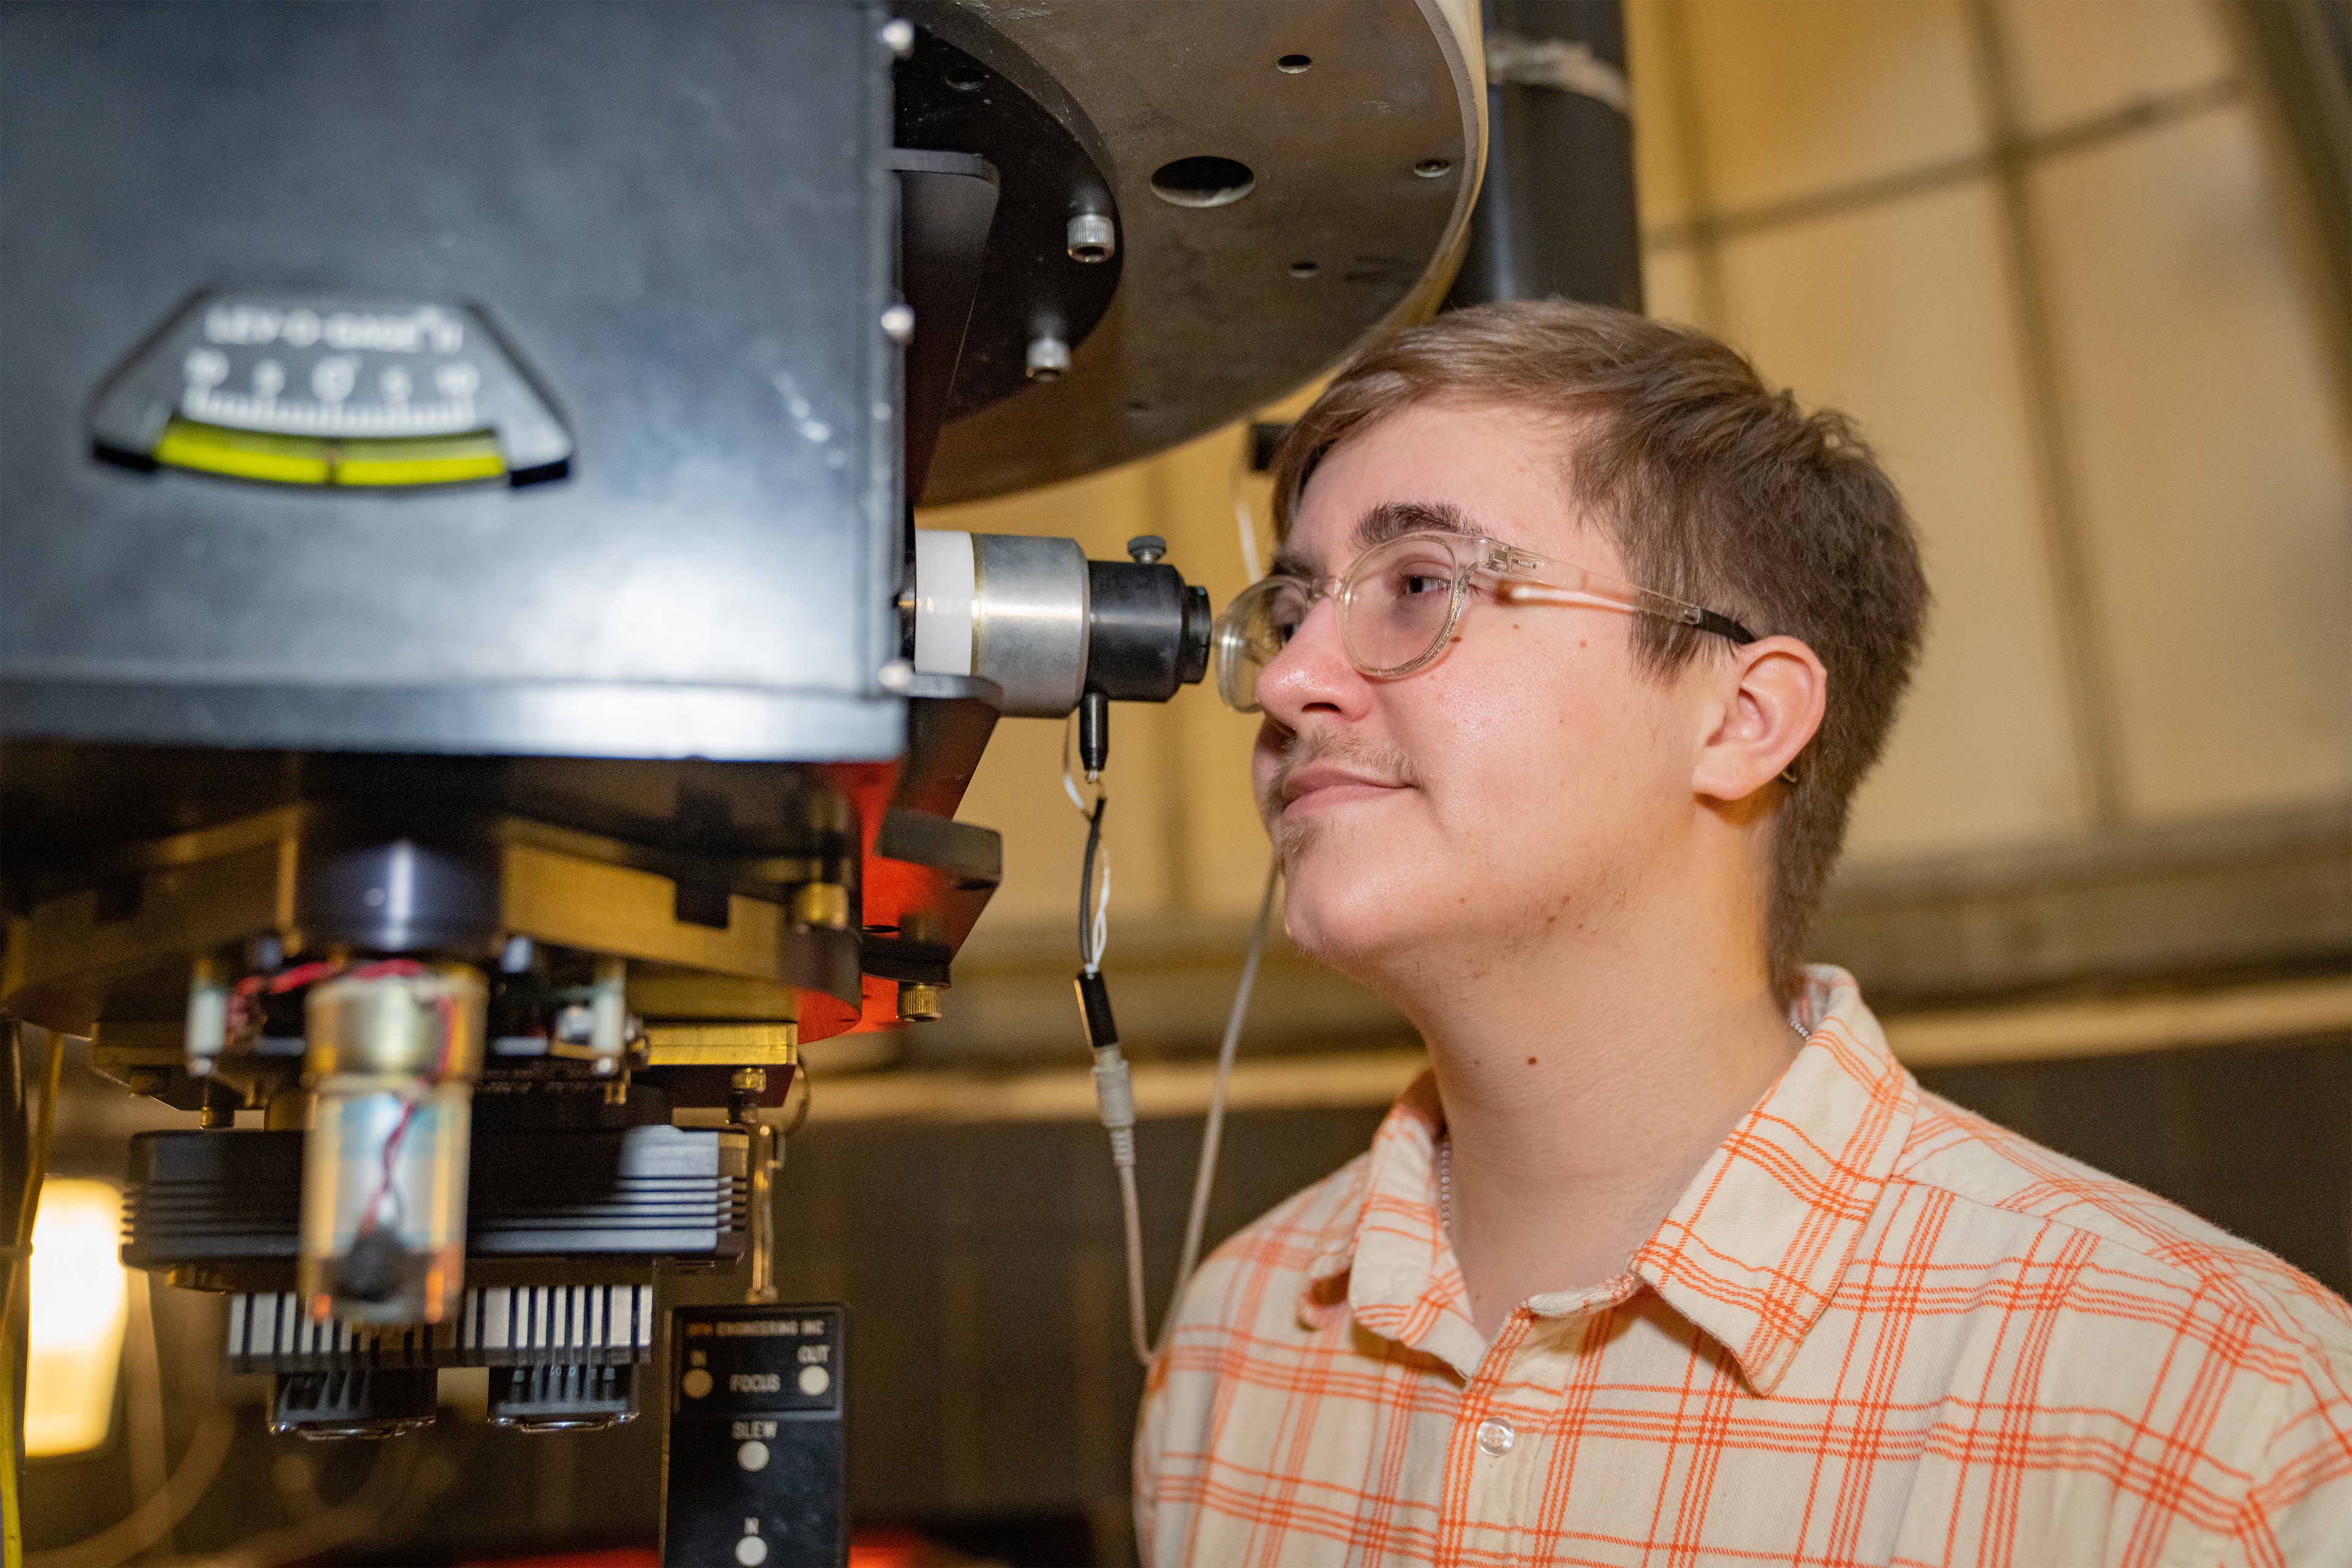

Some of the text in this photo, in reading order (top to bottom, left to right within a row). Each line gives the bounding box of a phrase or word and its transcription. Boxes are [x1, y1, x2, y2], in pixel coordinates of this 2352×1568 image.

[715, 1321, 799, 1336] ENGINEERING
[797, 1345, 831, 1364] OUT
[729, 1374, 781, 1393] FOCUS
[732, 1421, 778, 1439] SLEW
